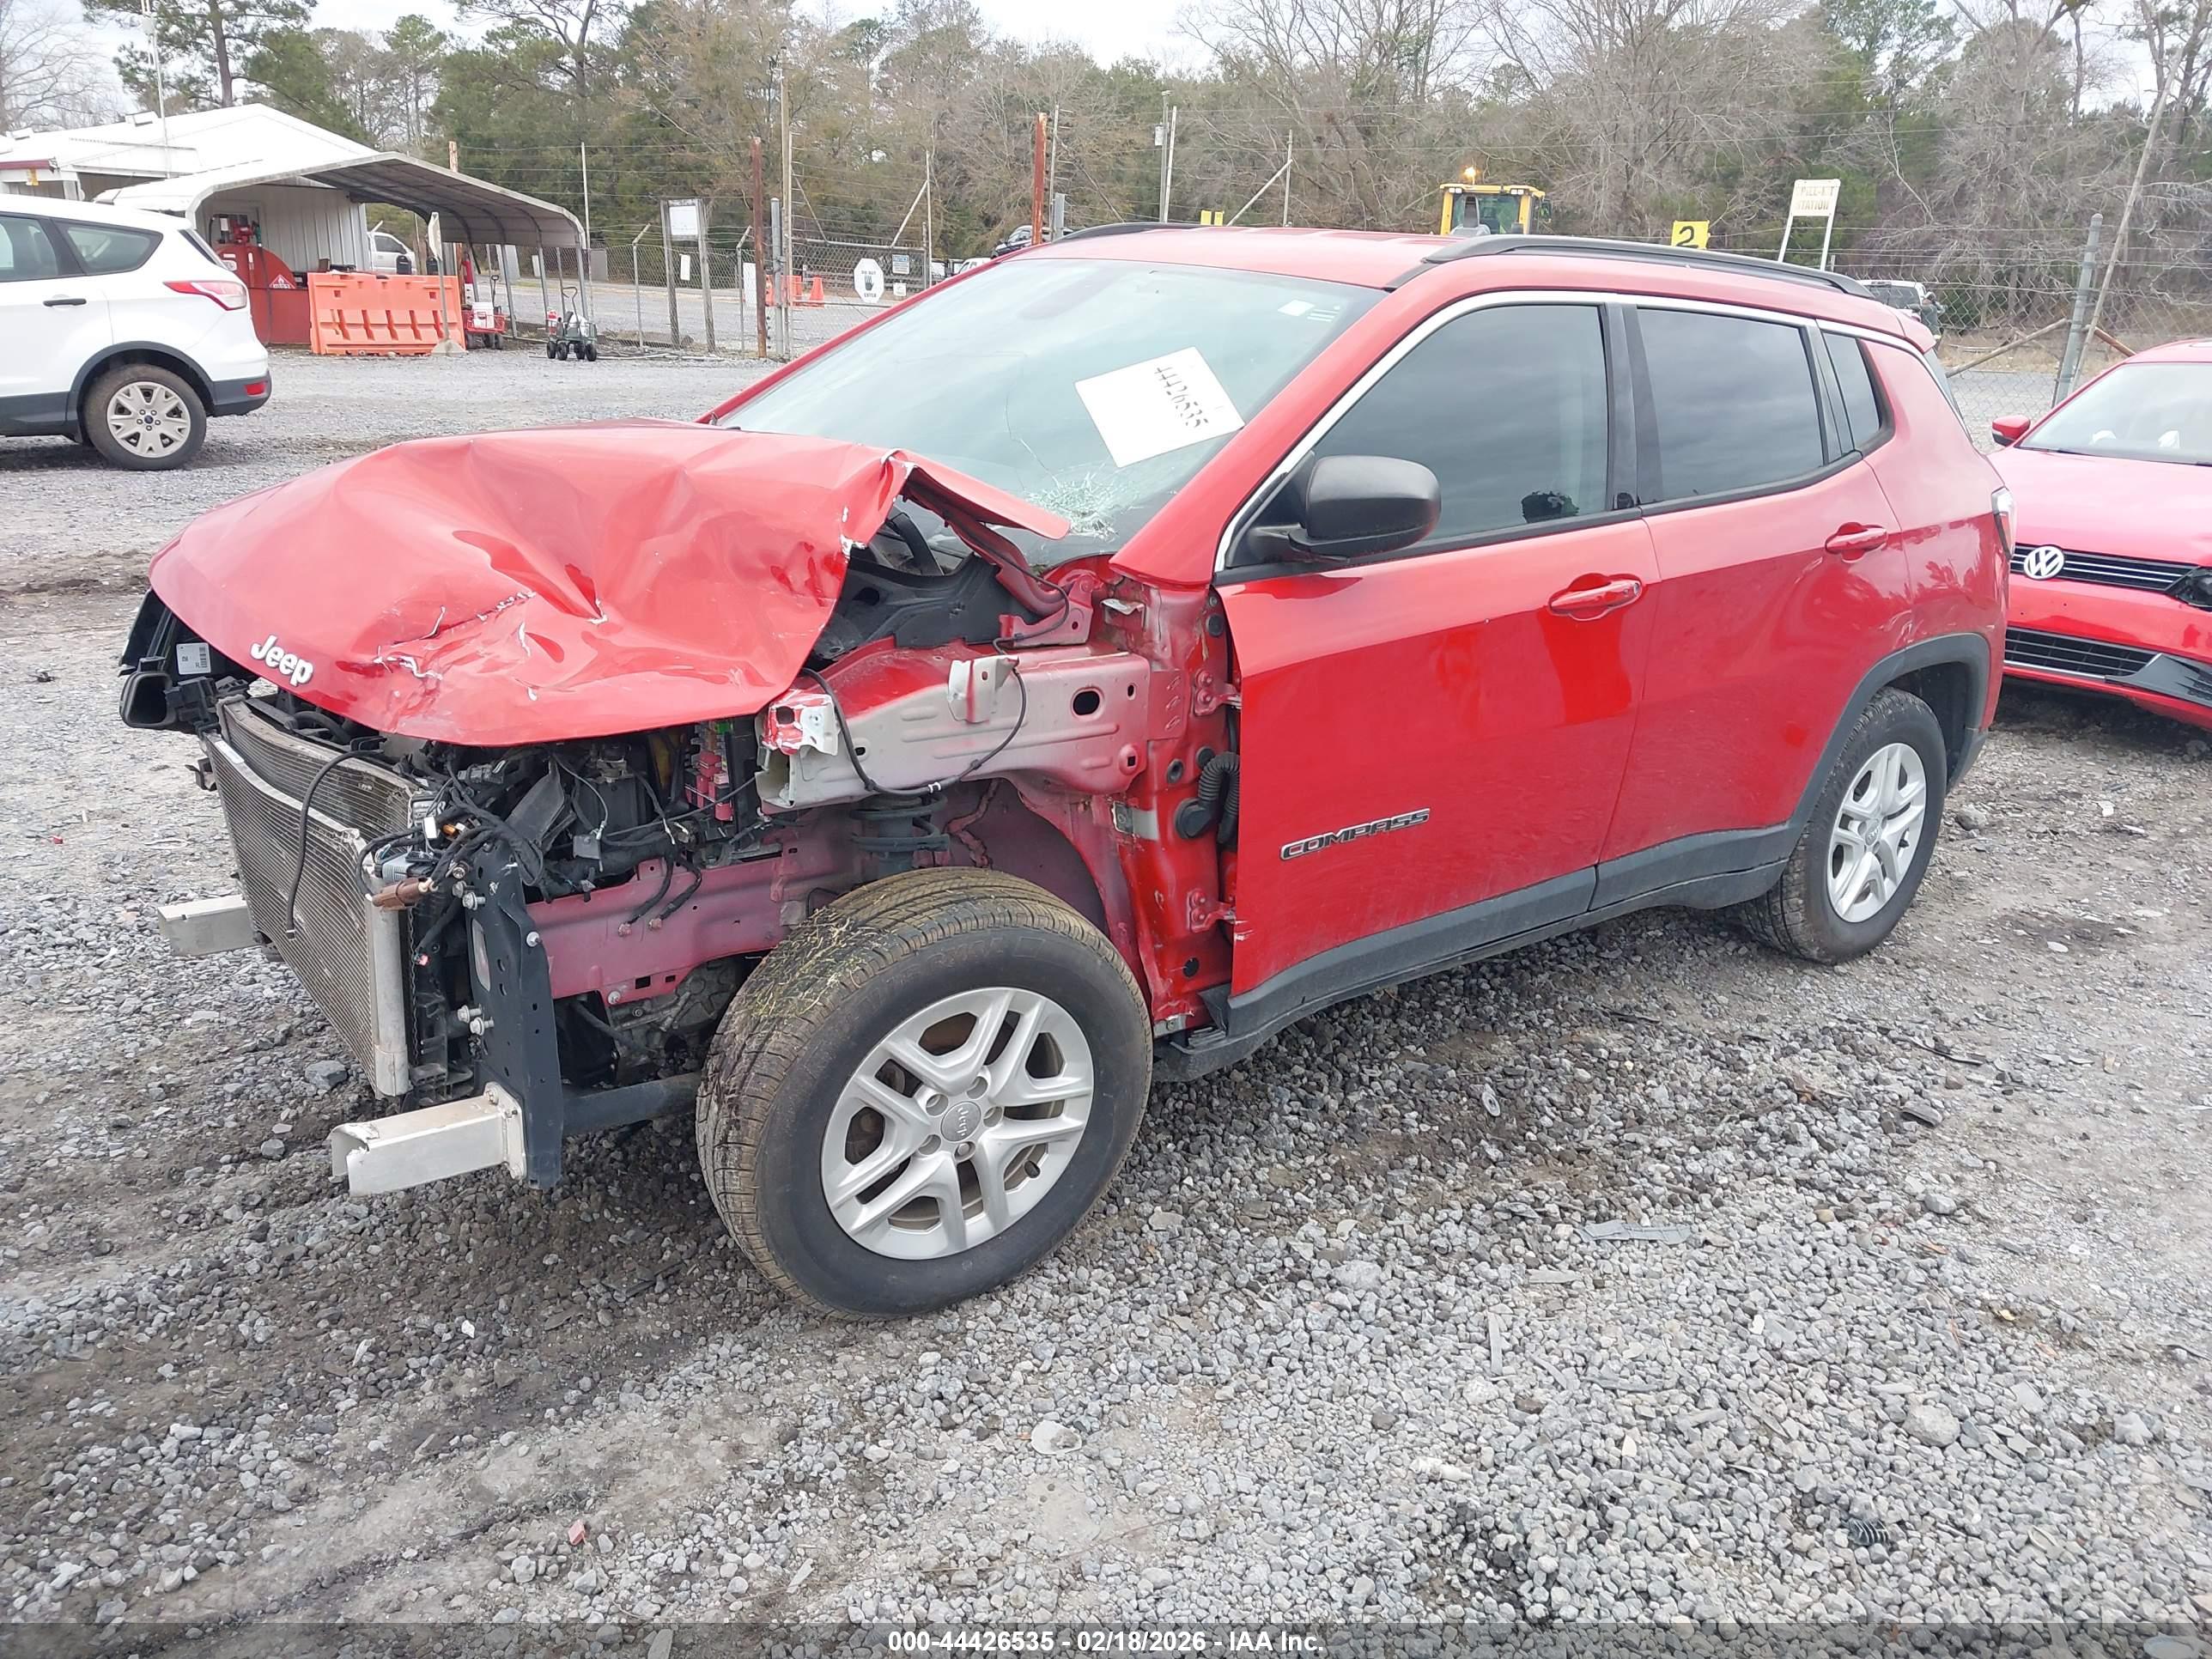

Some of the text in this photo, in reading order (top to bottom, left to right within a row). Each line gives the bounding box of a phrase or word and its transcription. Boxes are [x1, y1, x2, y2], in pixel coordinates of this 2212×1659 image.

[1676, 225, 1699, 248] 2
[1154, 367, 1209, 428] 44426535
[250, 634, 314, 687] Jeep
[1279, 807, 1431, 860] COMPASS
